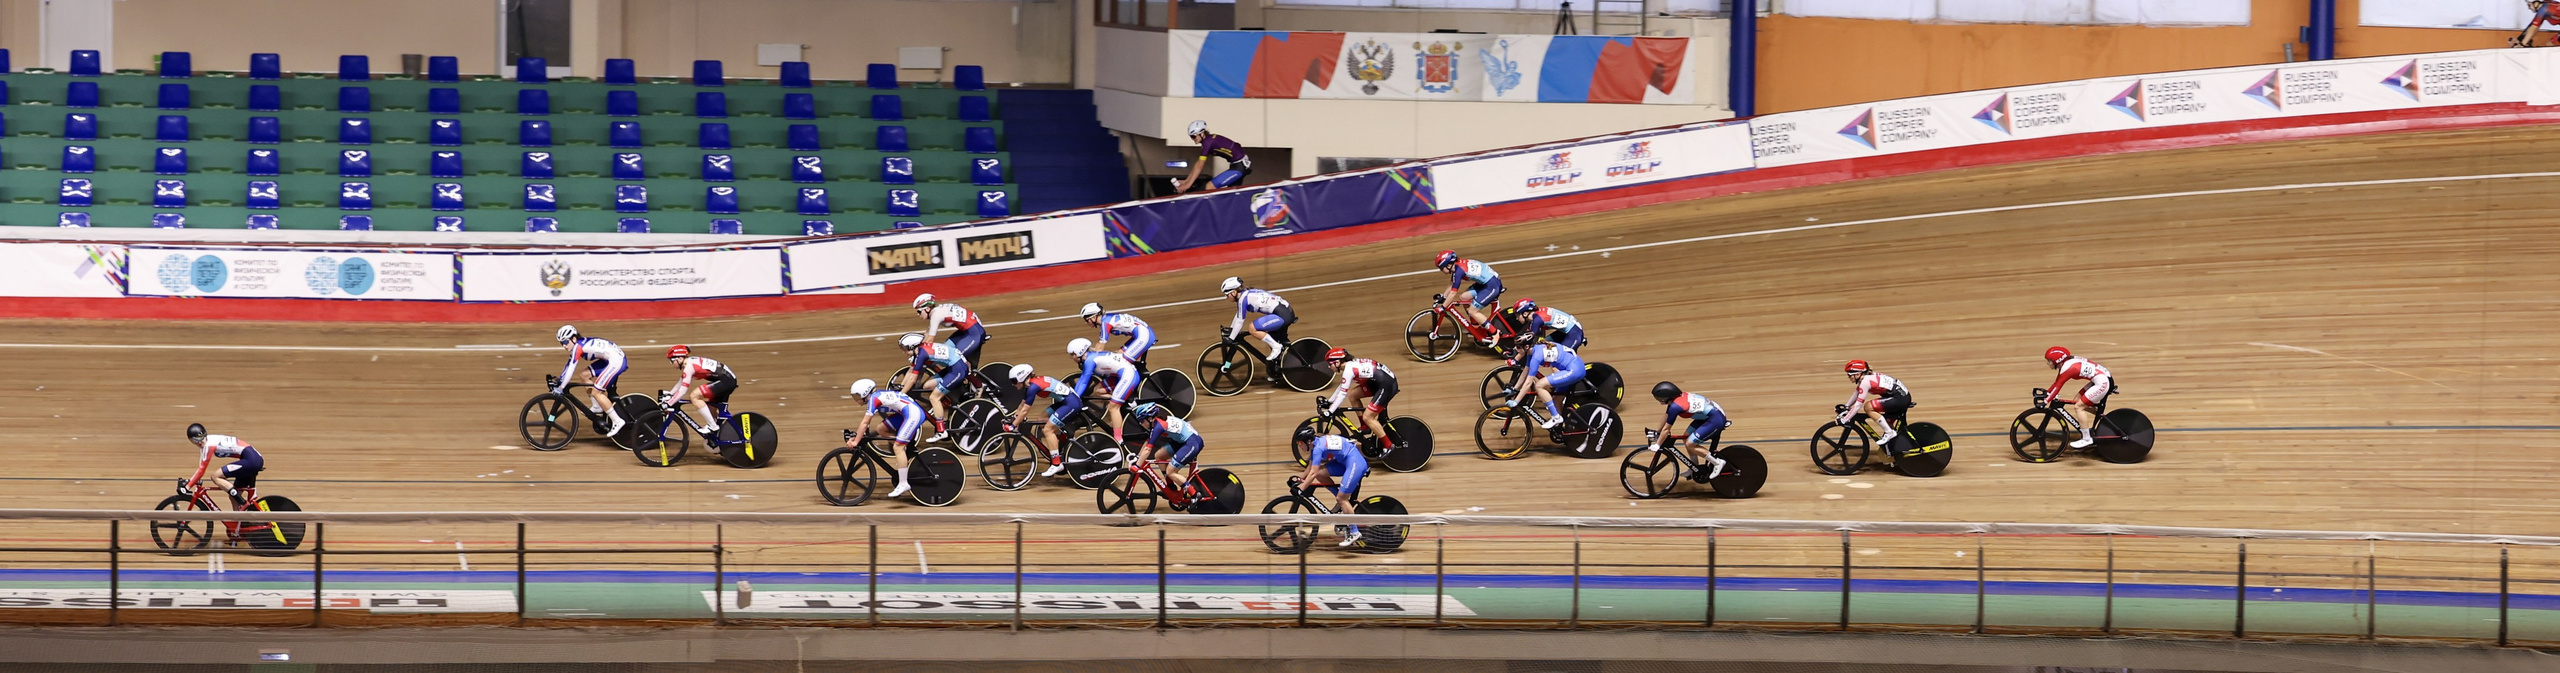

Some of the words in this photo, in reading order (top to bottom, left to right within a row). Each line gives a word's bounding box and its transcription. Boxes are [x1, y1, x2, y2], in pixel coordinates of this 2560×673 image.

[2422, 60, 2478, 73] RUSSIAN
[2284, 69, 2339, 83] RUSSIAN
[2423, 72, 2470, 85] COPPER
[2147, 80, 2201, 93] RUSSIAN
[2285, 82, 2331, 94] COPPER
[2424, 83, 2483, 96] COMPANY
[2013, 91, 2067, 107] RUSSIAN
[2148, 92, 2195, 105] COPPER
[2286, 92, 2344, 105] COMPANY
[1877, 106, 1932, 121] RUSSIAN
[2014, 104, 2060, 118] COPPER
[2149, 102, 2207, 116] COMPANY
[1879, 118, 1925, 133] COPPER
[2015, 114, 2073, 129] COMPANY
[1750, 122, 1797, 137] USSIAN
[1881, 128, 1938, 144] COMPANY
[1751, 134, 1790, 148] OPPER
[1753, 144, 1803, 159] OMPANY
[961, 235, 1031, 261] МАТЧ!
[870, 245, 940, 270] МАТЧ!
[580, 269, 656, 277] МИНИСТЕРСТВО
[658, 267, 696, 276] СПОРТА
[1470, 264, 1479, 272] 57
[580, 278, 645, 287] РОССИЙСКОЙ
[647, 277, 707, 286] ФЕДЕРАЦИИ
[937, 347, 946, 356] 52
[2083, 366, 2092, 375] 40
[1692, 401, 1702, 409] 55
[678, 410, 701, 433] PINAREL
[2057, 407, 2080, 429] ARGON
[1595, 417, 1614, 452] CORIMA
[1669, 447, 1692, 467] ARGON
[1080, 466, 1118, 480] CORIMA
[779, 600, 1233, 611] TISSOT
